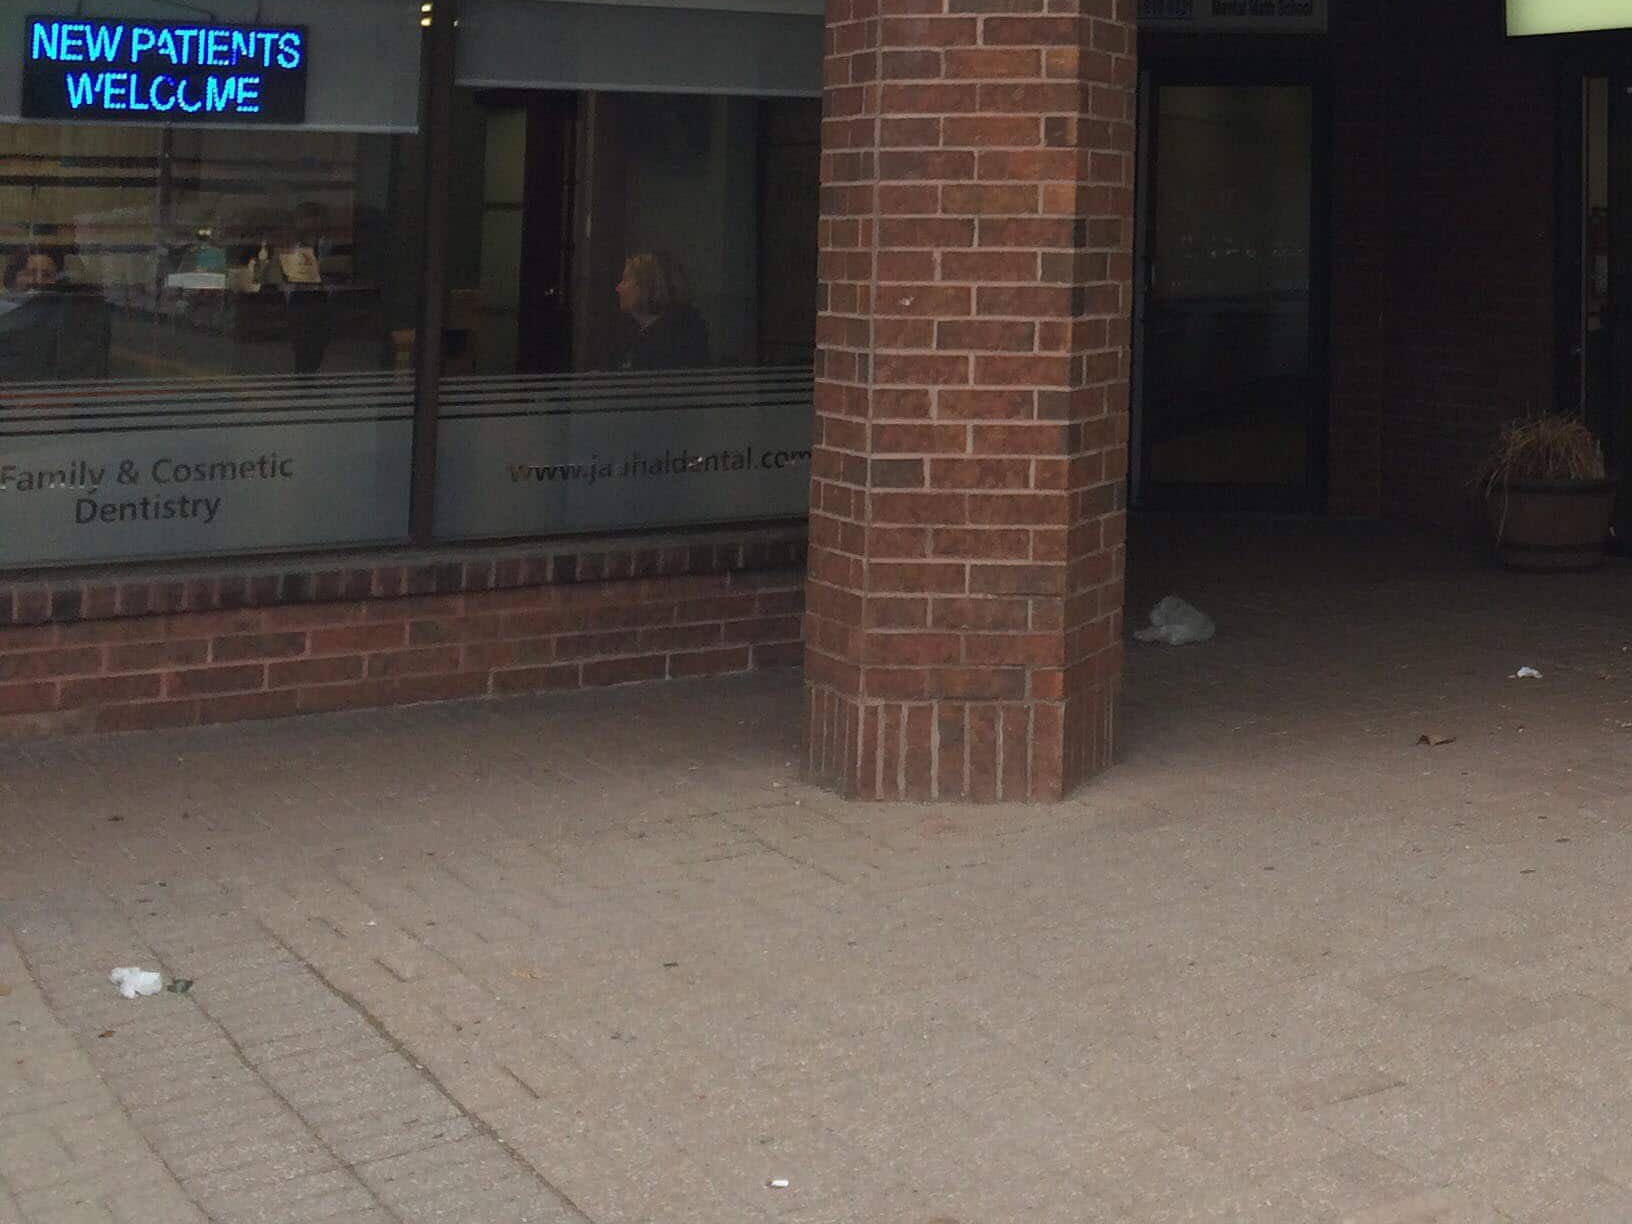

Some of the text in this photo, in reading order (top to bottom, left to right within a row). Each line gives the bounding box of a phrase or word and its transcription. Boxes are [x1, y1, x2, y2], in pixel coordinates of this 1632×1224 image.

[32, 22, 301, 68] NEW PATIENTS
[117, 459, 139, 485] &
[152, 453, 294, 484] Cosmetic
[76, 493, 222, 524] Dentistry
